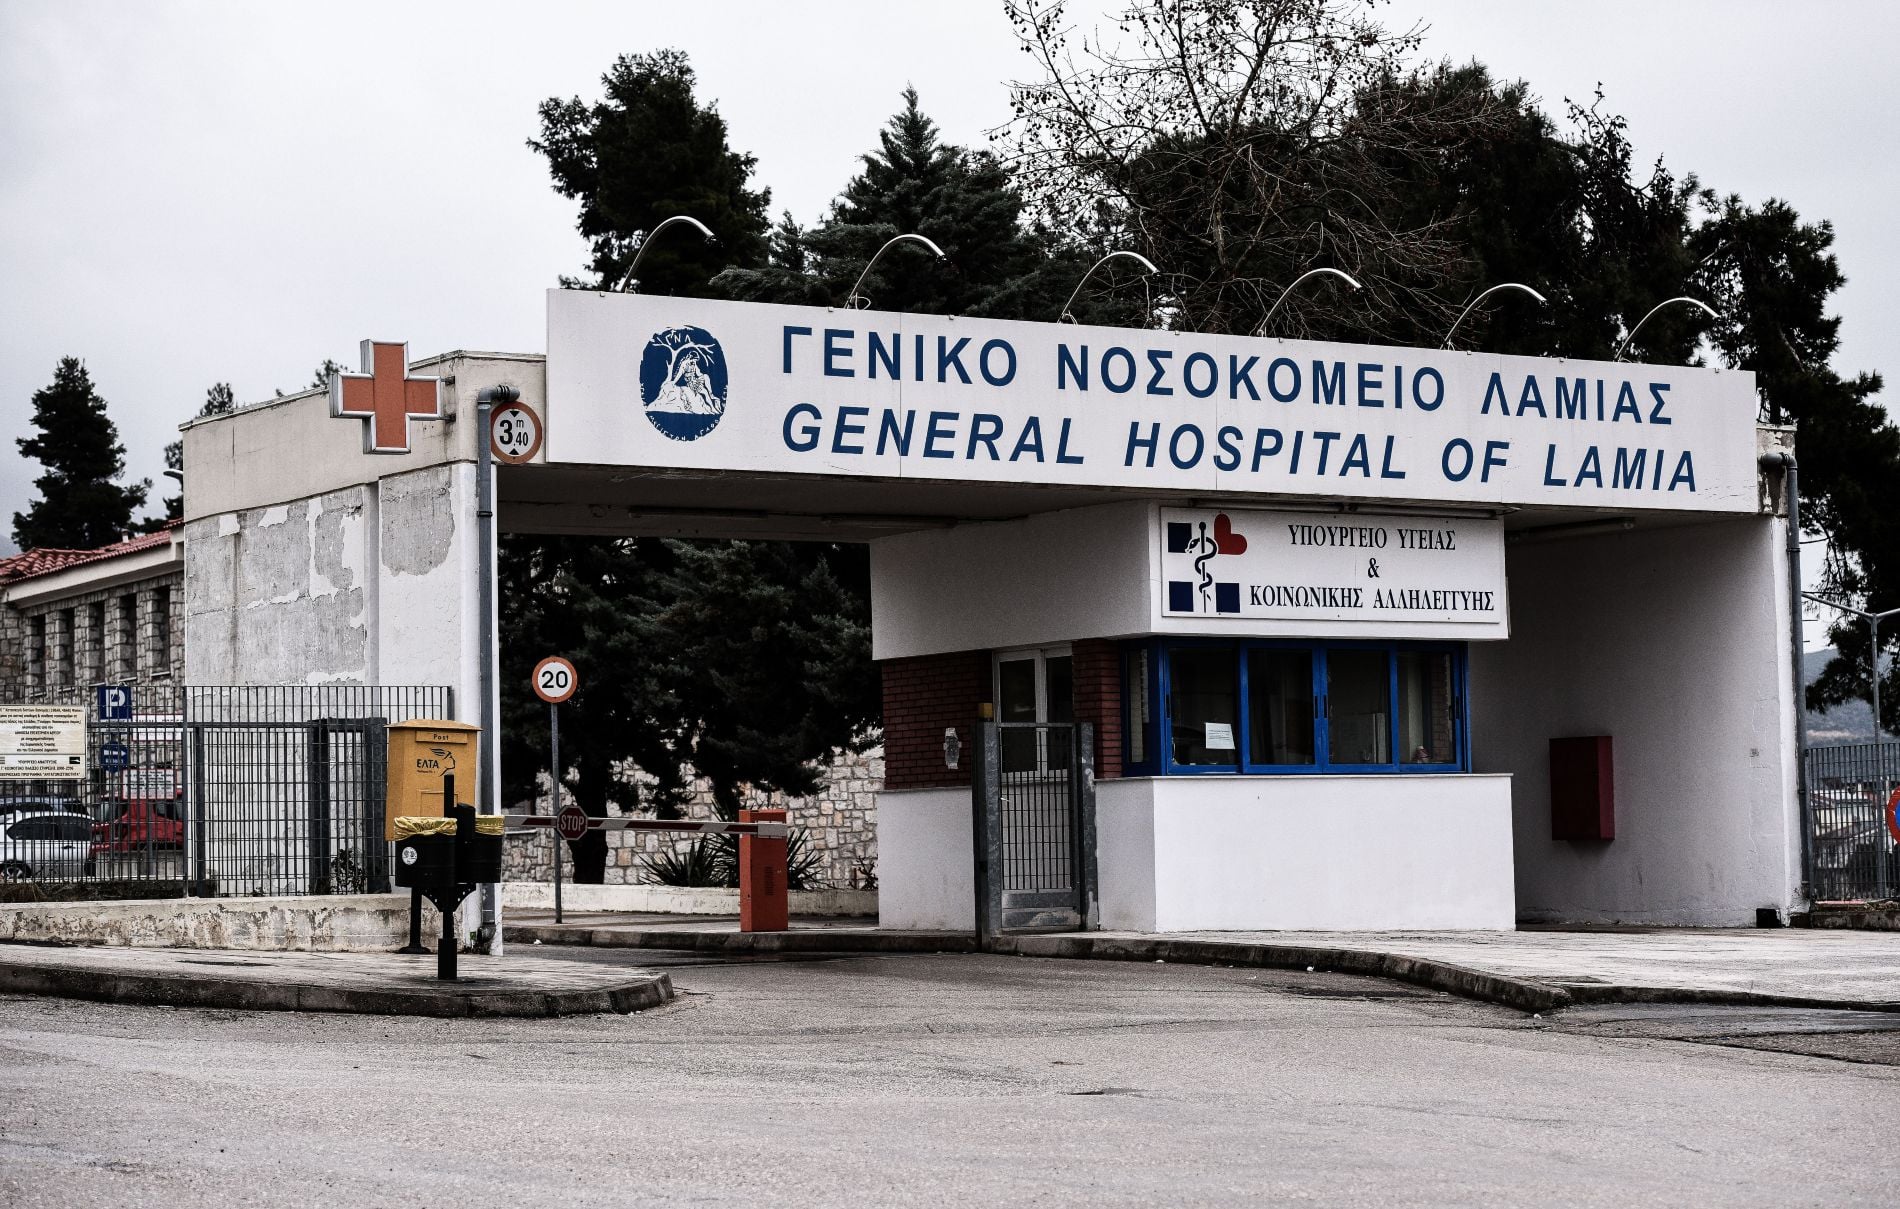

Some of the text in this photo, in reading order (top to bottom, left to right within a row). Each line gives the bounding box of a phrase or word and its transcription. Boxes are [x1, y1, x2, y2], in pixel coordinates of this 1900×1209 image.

[783, 325, 1673, 425] ΓΕΝΙΚΟ ΝΟΣΟΚΟΜΕΙΟ ΛΑΜΙΑΣ
[782, 402, 1697, 493] GENERAL HOSPITAL OF LAMIA
[1287, 524, 1456, 551] ΥΠΟΥΡΓΕΙΟ ΥΓΕΙΑΣ
[1367, 557, 1380, 579] &
[1250, 585, 1495, 611] ΚΟΙΝΩΝΙΚΗΣ ΑΛΛΗΛΕΓΓΥΗΣ
[541, 670, 569, 689] 20
[105, 689, 126, 718] P
[433, 733, 450, 741] Post
[416, 758, 440, 769] ΕΛΤΑ
[560, 814, 585, 832] STOP
